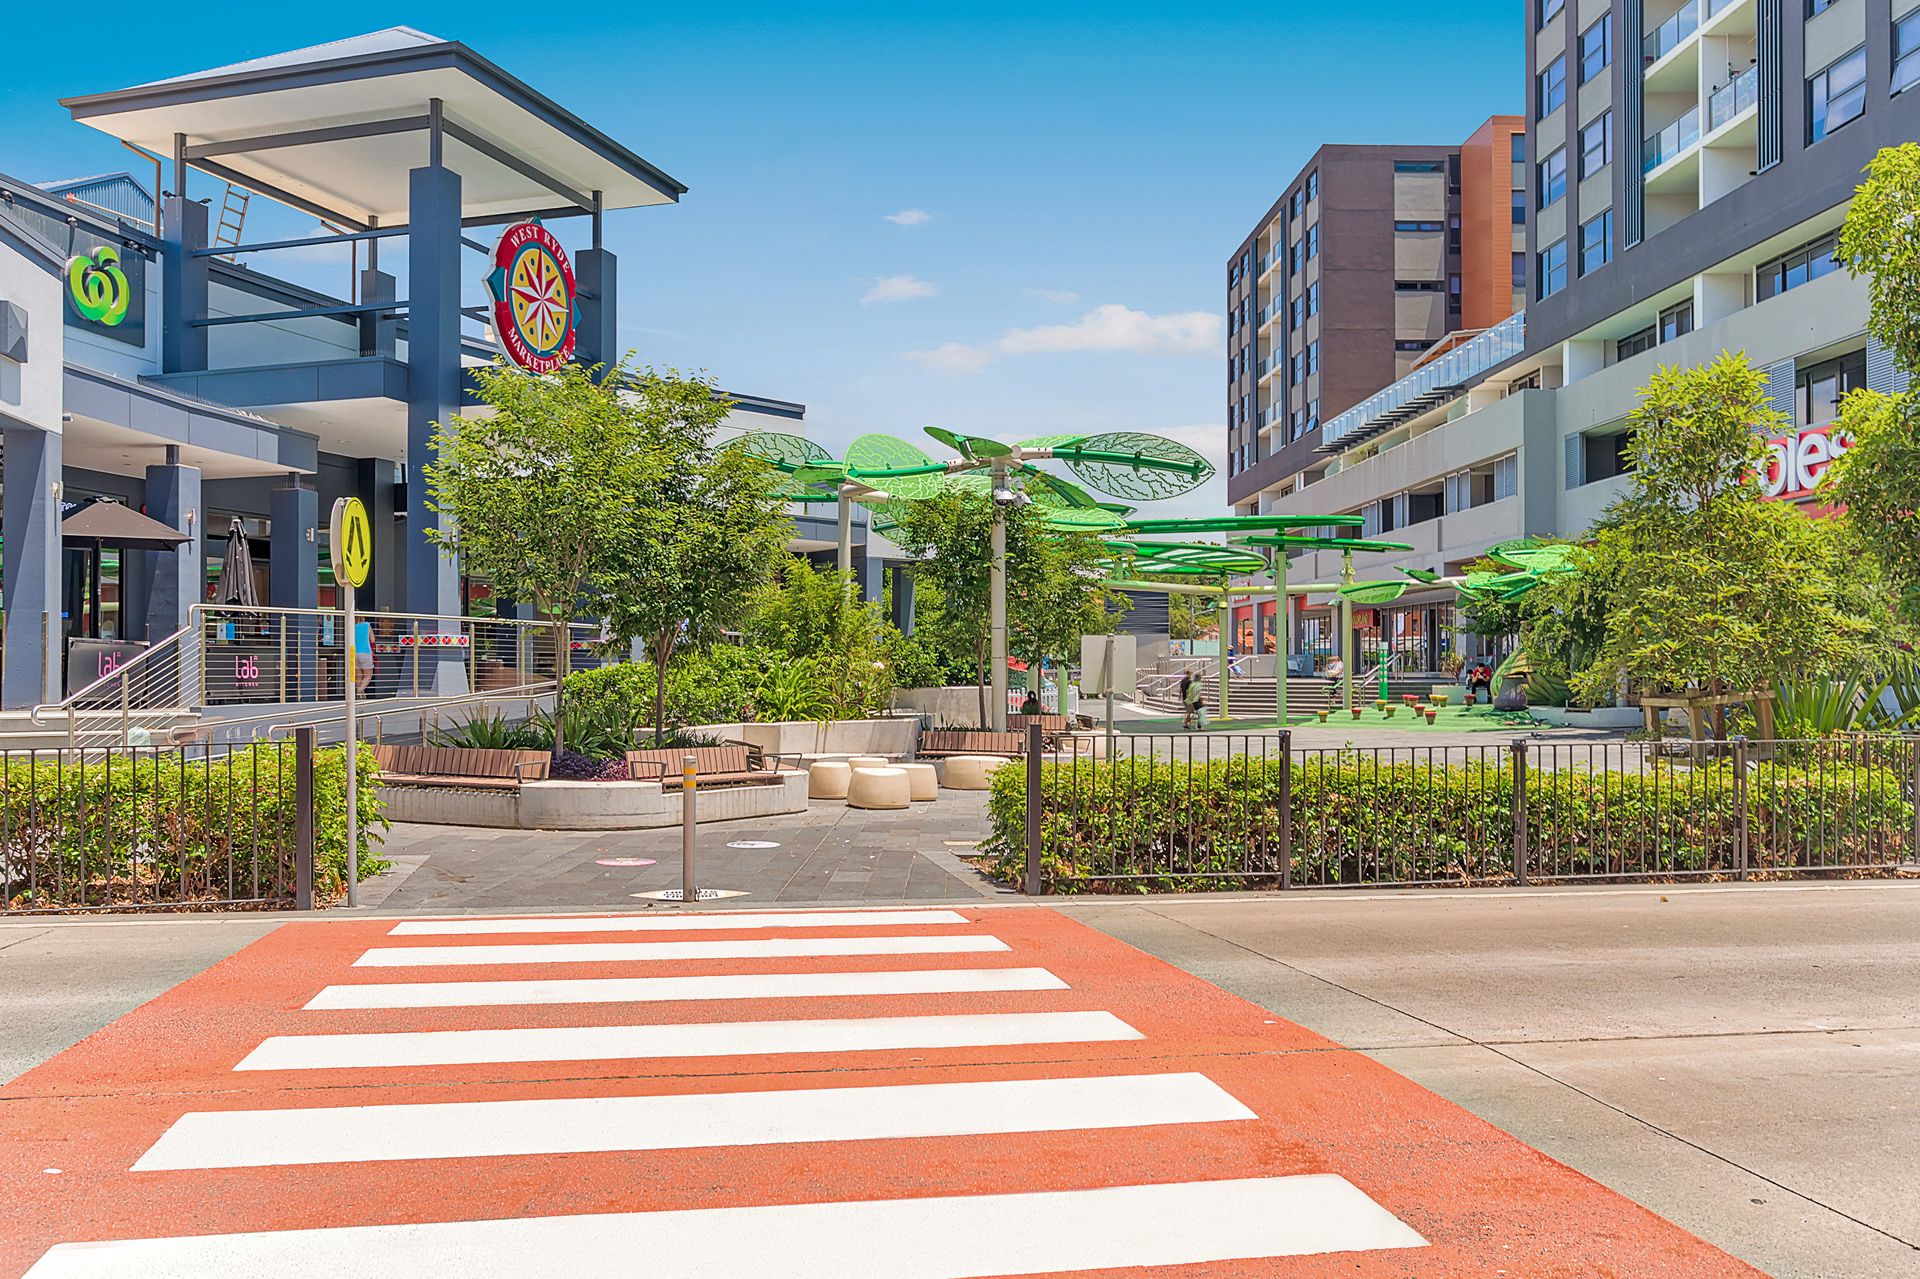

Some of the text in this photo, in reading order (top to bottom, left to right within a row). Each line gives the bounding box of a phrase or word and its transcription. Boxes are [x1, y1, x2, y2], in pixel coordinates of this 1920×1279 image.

[510, 226, 570, 273] WEST RYDE
[235, 655, 259, 679] lab
